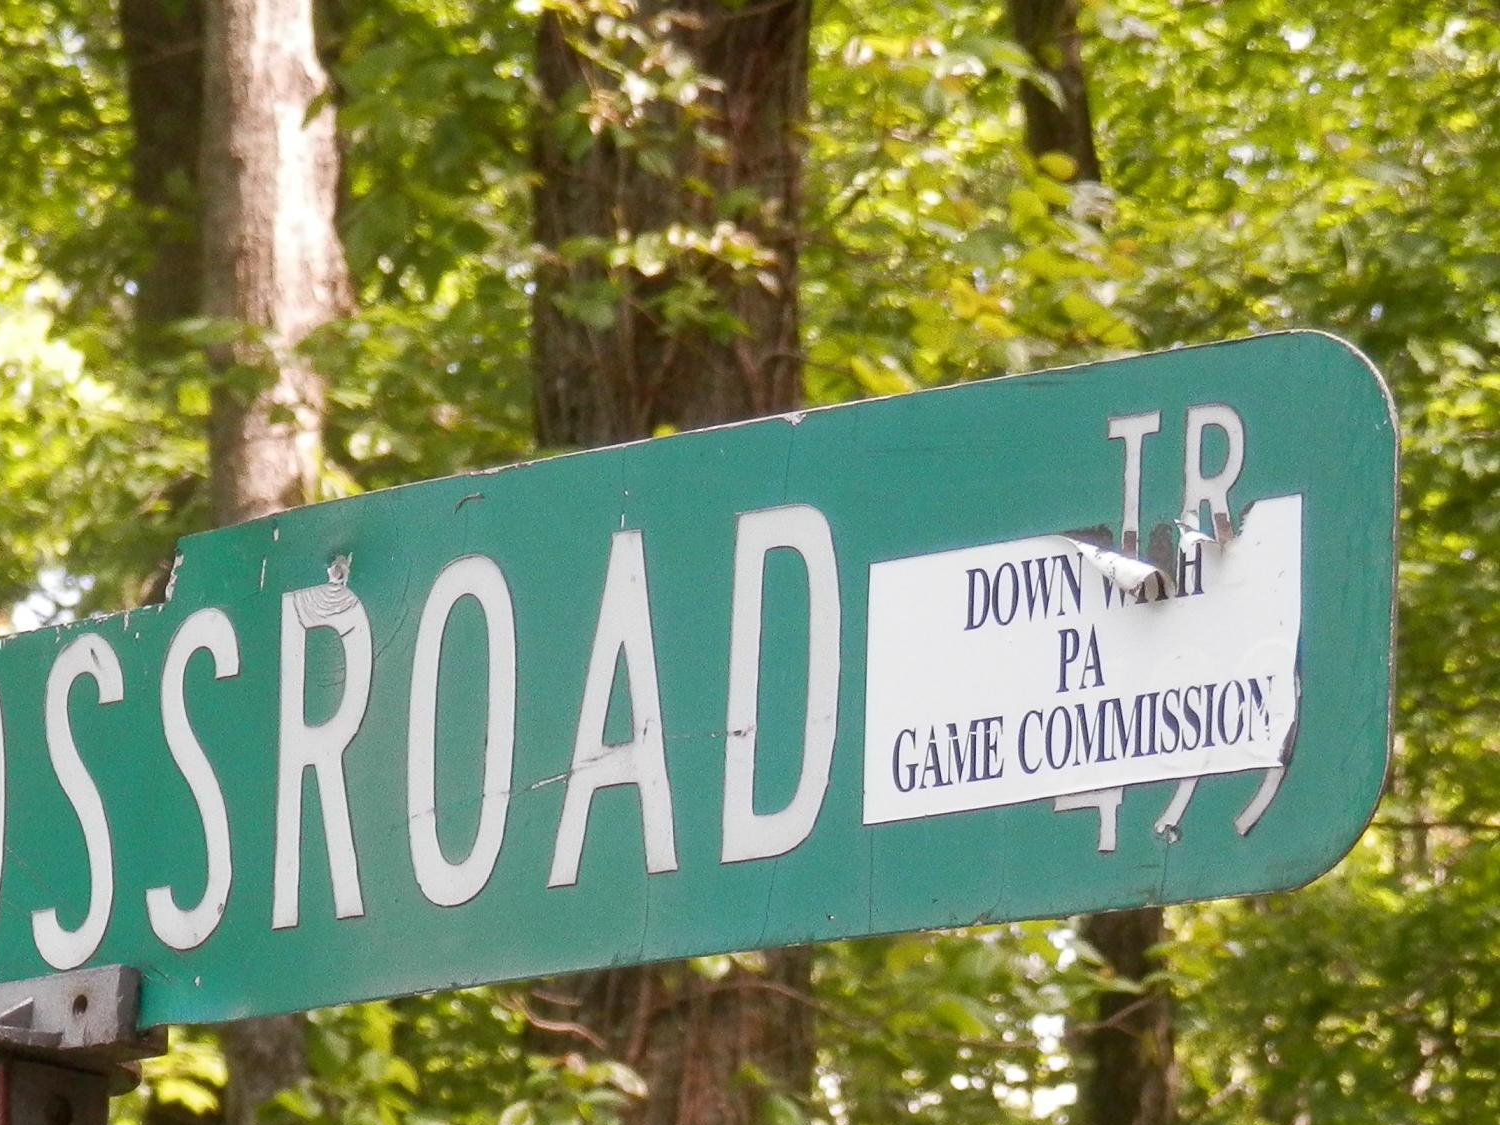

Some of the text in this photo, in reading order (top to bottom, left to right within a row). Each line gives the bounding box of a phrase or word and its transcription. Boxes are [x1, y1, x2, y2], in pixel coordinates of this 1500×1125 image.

[1106, 403, 1245, 558] TR
[963, 553, 1084, 632] DOWN
[1055, 624, 1105, 694] PA
[891, 675, 1276, 793] GAME COMMISSION
